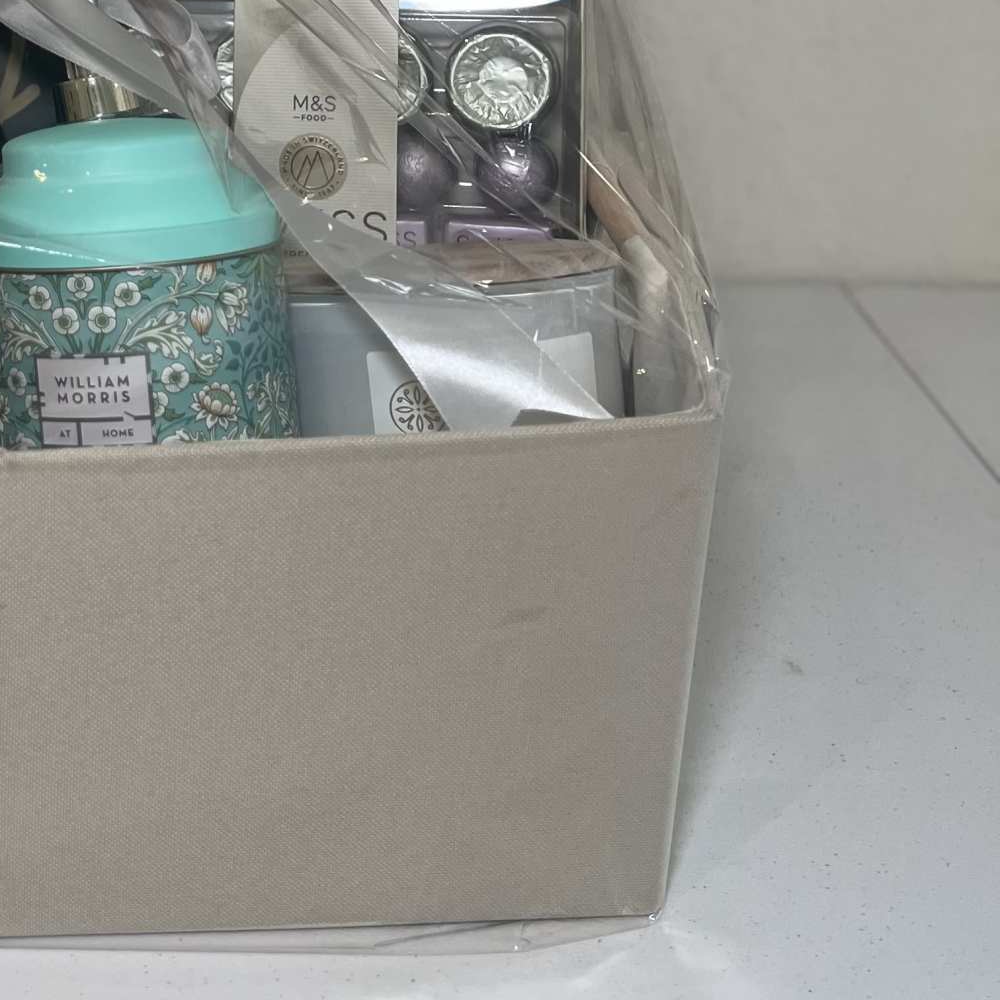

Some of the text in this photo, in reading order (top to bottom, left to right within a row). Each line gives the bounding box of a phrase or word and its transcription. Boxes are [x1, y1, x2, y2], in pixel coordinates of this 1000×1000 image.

[293, 94, 337, 112] M&S
[301, 114, 327, 122] FOOD
[54, 375, 130, 389] WILLIAM
[57, 390, 131, 405] MORRIS
[59, 428, 134, 439] AT HOME
